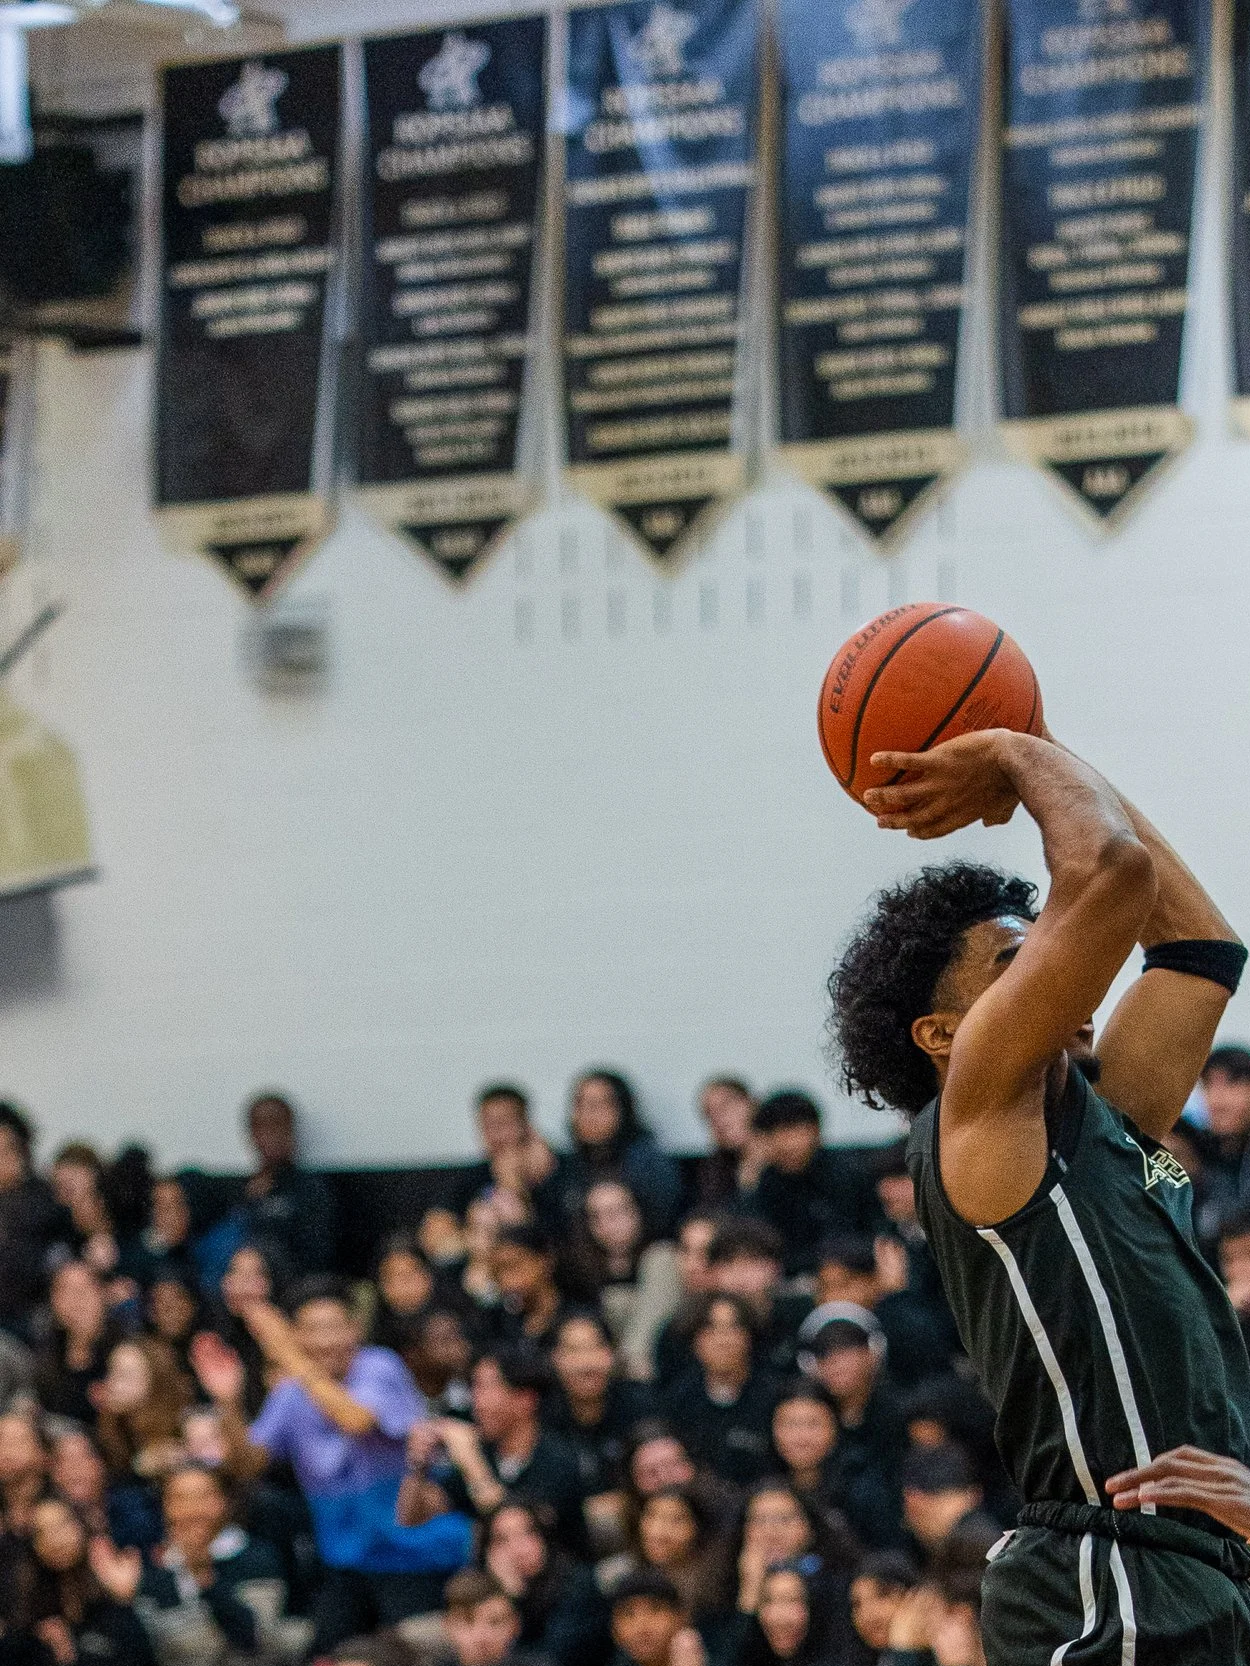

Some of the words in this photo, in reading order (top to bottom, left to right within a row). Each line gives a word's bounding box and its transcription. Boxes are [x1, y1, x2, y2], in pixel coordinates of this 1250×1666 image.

[1022, 46, 1192, 96] CHAMPIONS
[798, 79, 962, 127] CHAMPIONS
[377, 131, 534, 182] CHAMPIONS
[178, 157, 330, 208] CHAMPIONS
